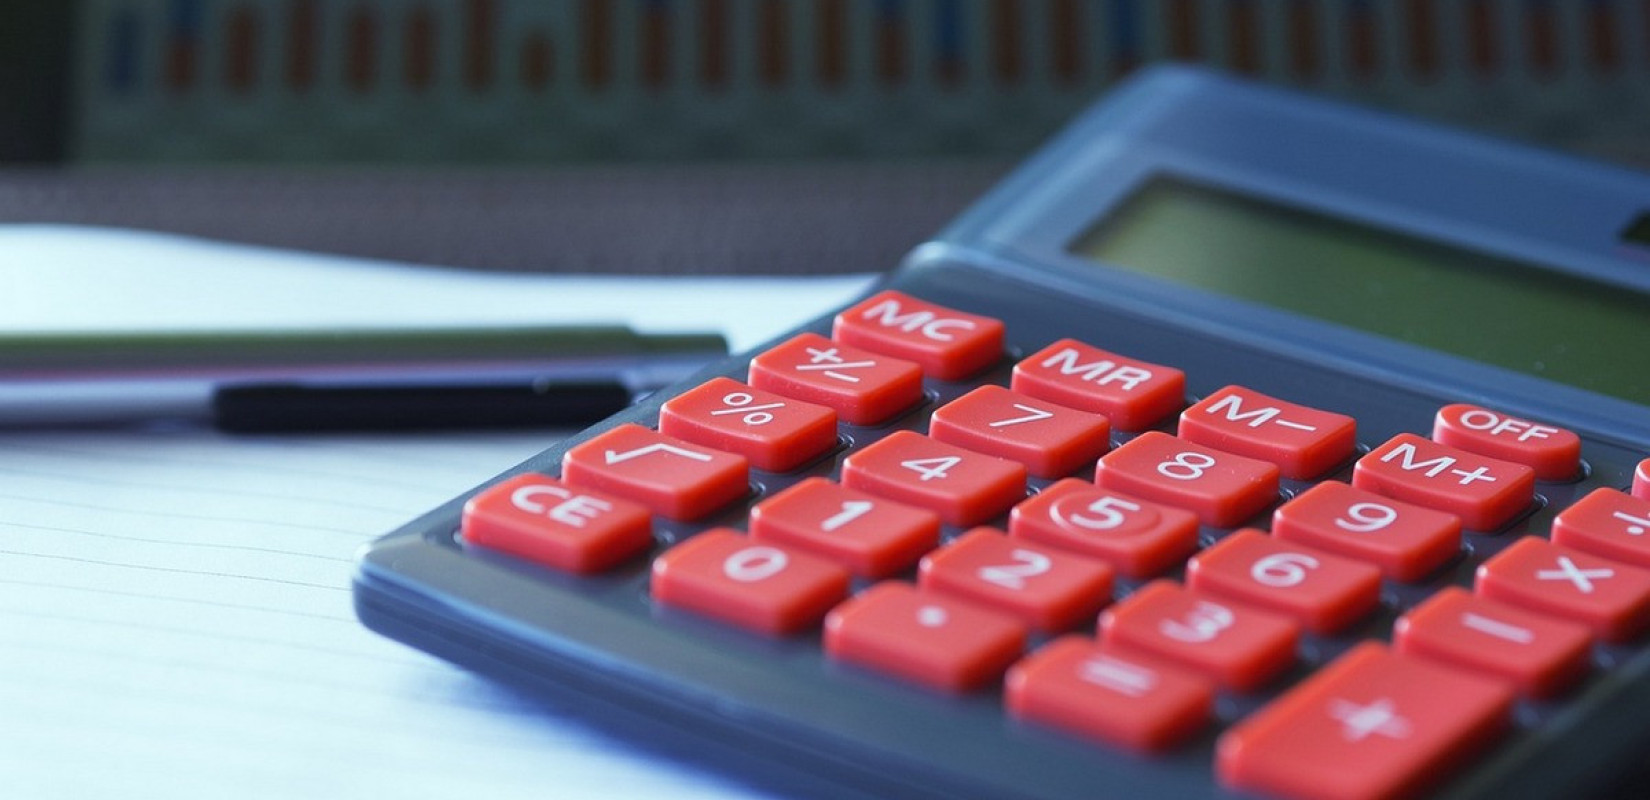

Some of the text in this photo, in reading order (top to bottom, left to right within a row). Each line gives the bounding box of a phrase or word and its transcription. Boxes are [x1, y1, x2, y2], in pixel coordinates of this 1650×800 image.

[863, 298, 976, 342] MC
[1043, 348, 1153, 391] MR
[711, 392, 785, 426] %
[989, 403, 1053, 427] 7
[1460, 410, 1559, 442] OFF
[901, 456, 961, 481] 4
[1157, 451, 1216, 480] 8
[1382, 441, 1497, 485] M+
[511, 484, 611, 527] CE
[821, 501, 873, 531] 1
[1070, 496, 1140, 529] 5
[1336, 503, 1398, 532] 9
[723, 547, 788, 581] 0
[979, 549, 1052, 590] 2
[1251, 553, 1319, 587] 6
[1162, 602, 1234, 642] 3
[1332, 698, 1408, 741] +
